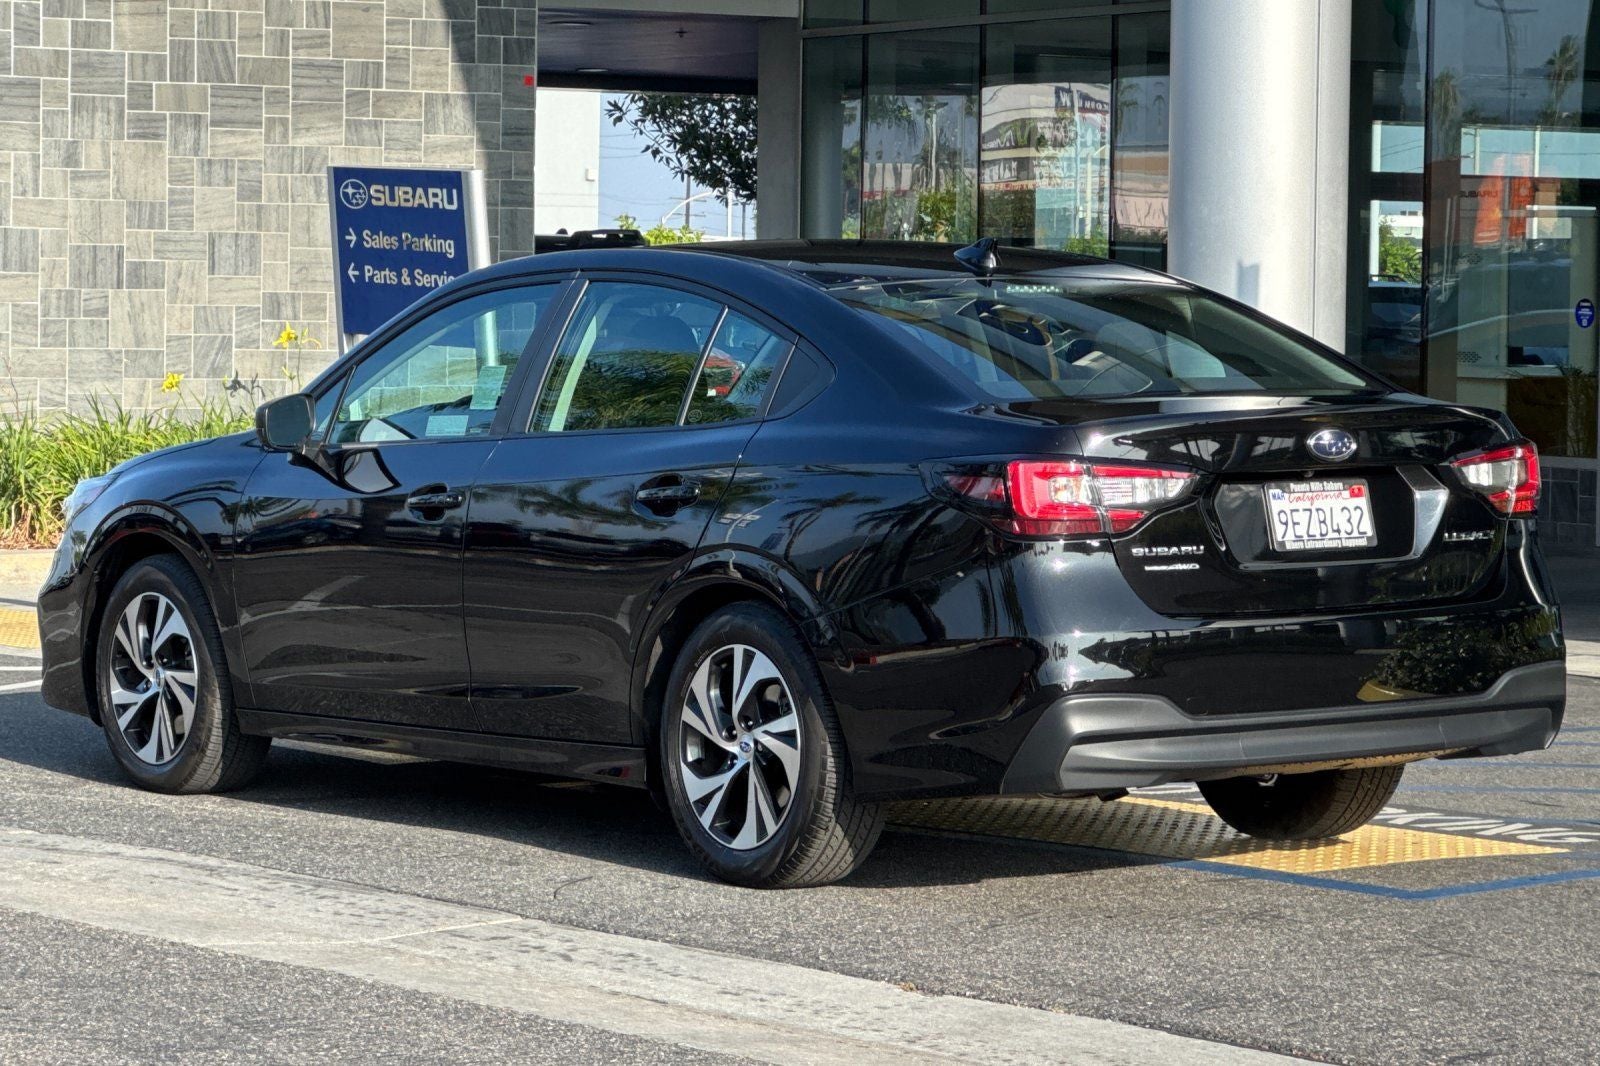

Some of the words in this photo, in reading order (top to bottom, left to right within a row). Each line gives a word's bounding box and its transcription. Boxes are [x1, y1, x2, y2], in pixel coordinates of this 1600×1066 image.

[370, 185, 458, 210] SUBARU
[363, 230, 399, 249] Sales
[402, 232, 455, 258] Parking
[364, 265, 398, 285] Parts
[401, 268, 411, 286] &
[1288, 492, 1348, 506] California
[1278, 506, 1367, 539] 9EZB432
[1131, 545, 1205, 556] SUBARU
